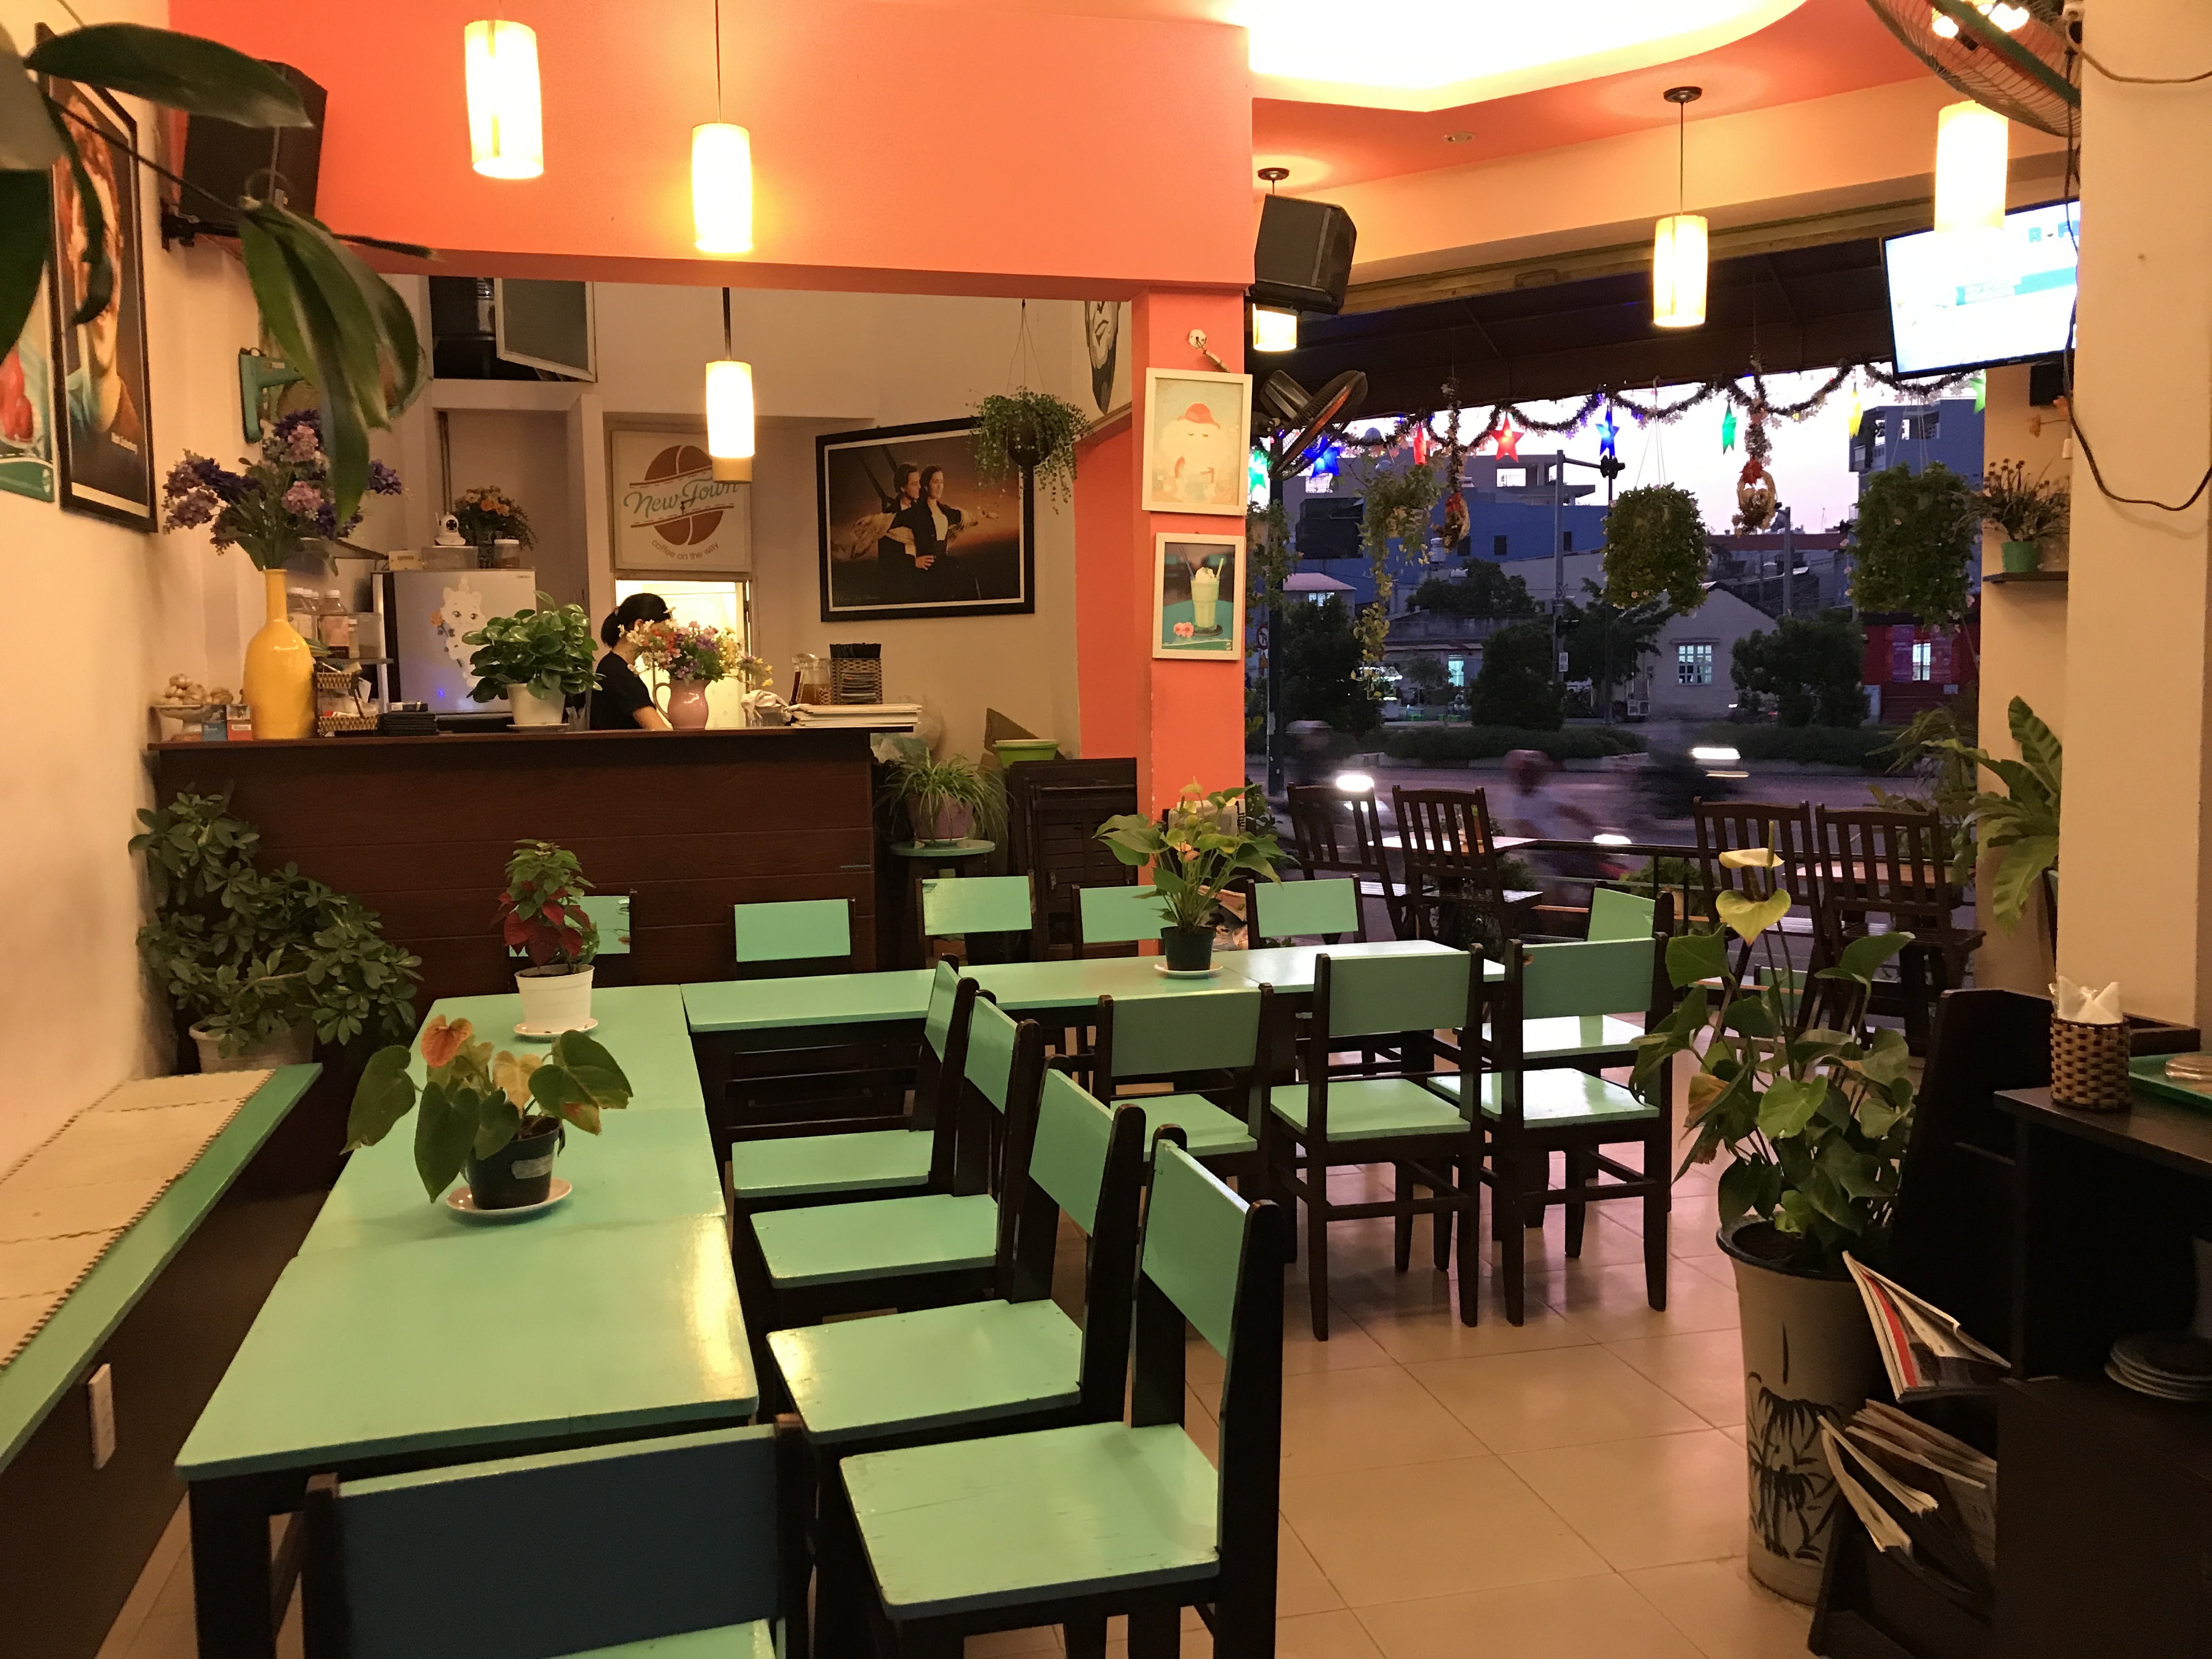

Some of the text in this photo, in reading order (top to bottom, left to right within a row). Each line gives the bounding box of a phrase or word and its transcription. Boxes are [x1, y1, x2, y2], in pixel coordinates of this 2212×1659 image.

[651, 539, 675, 558] coffee
[689, 552, 703, 560] the
[703, 541, 719, 555] way
